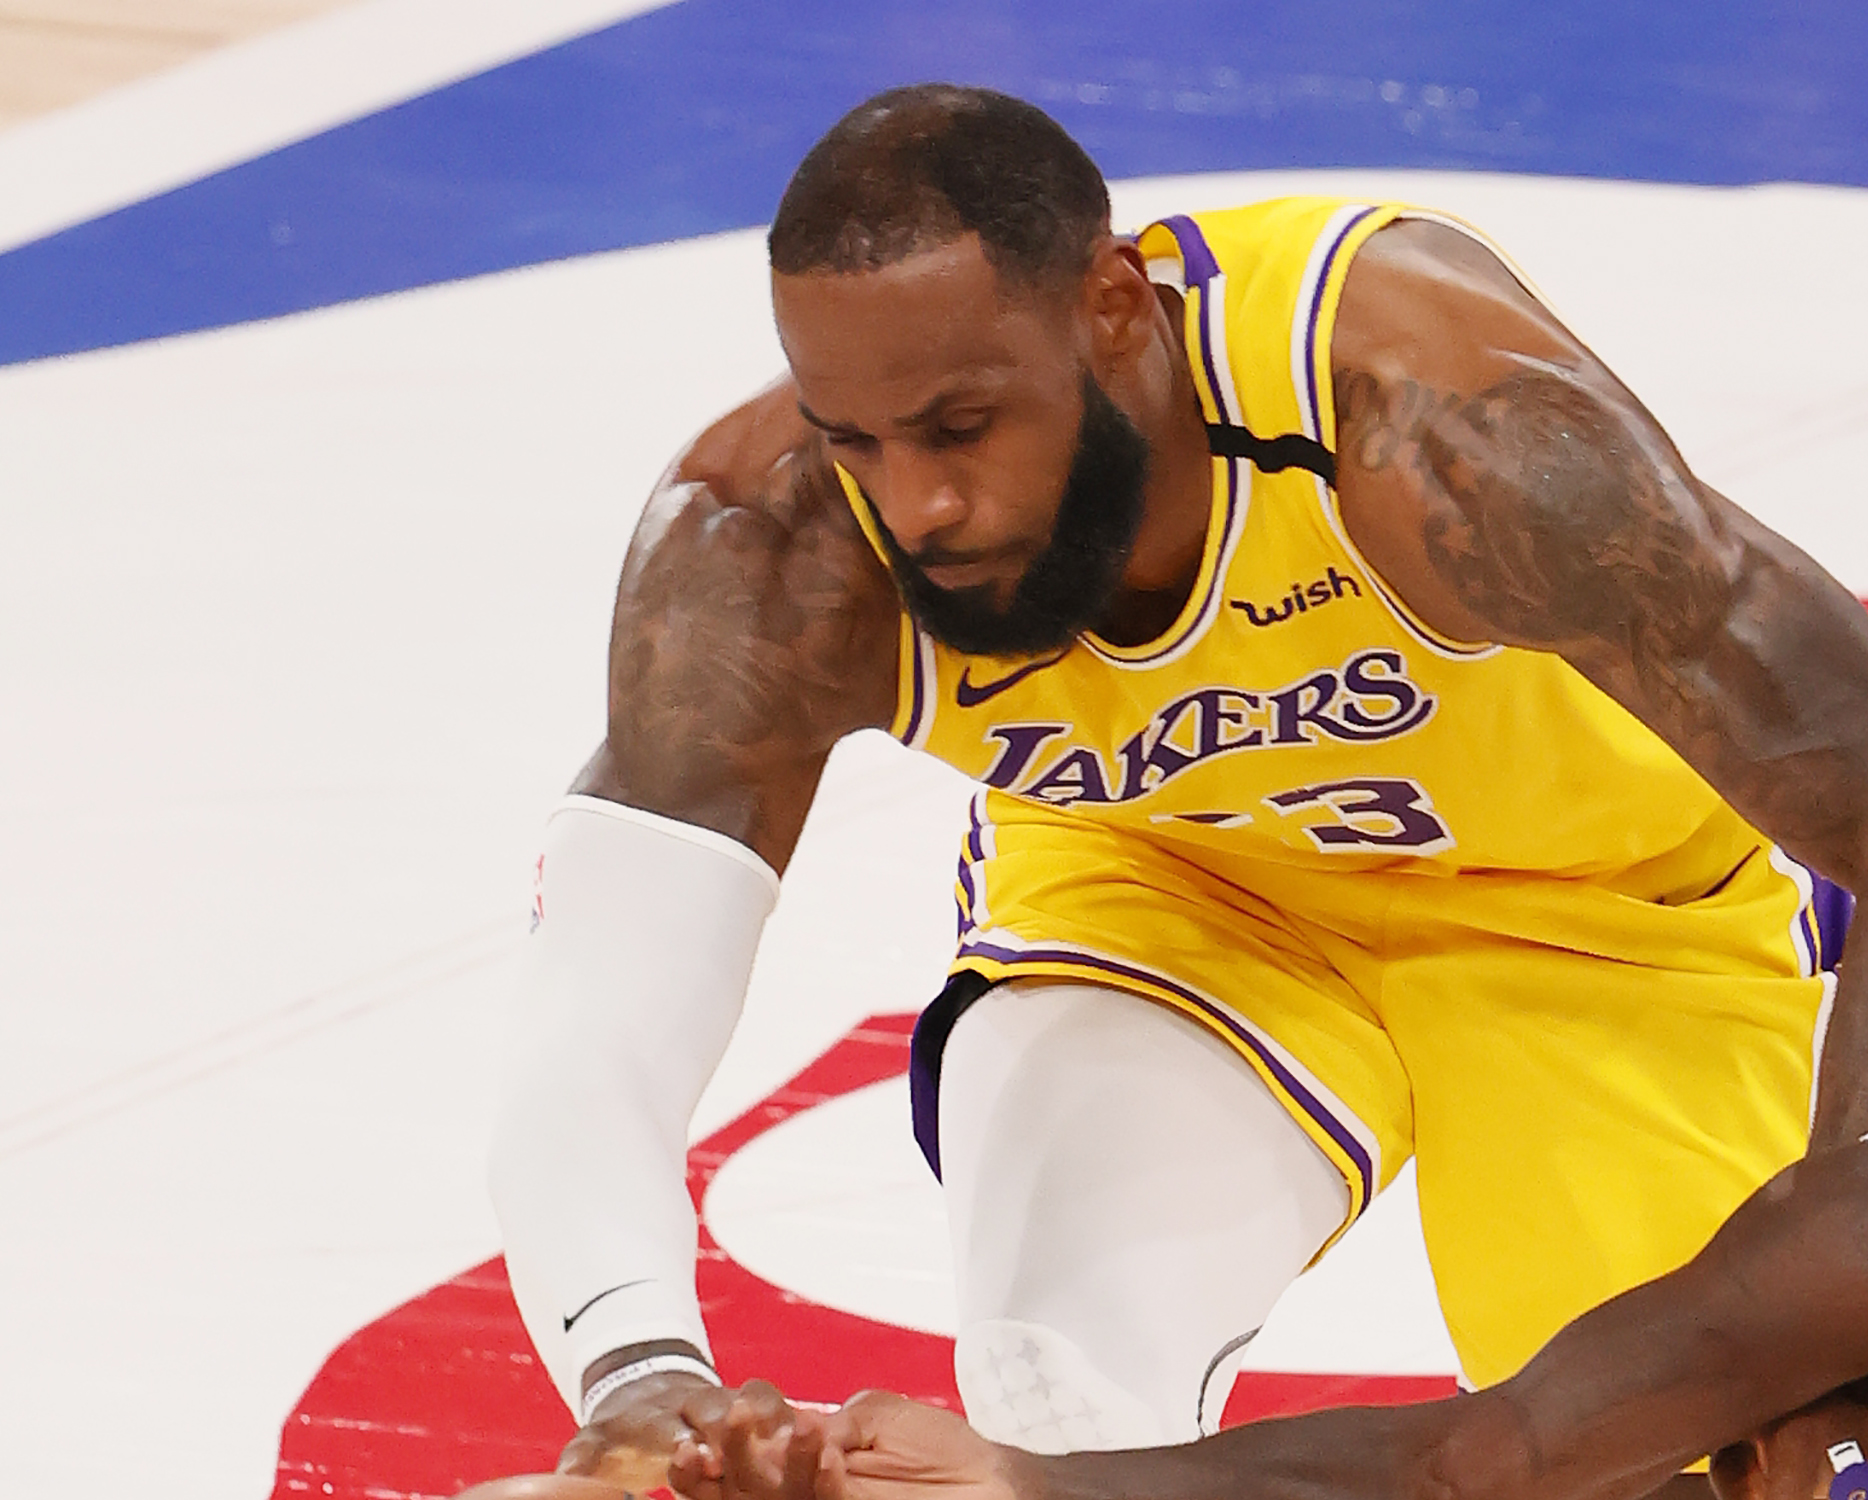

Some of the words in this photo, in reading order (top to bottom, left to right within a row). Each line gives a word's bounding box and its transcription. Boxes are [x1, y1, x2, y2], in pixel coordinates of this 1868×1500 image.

[1230, 566, 1363, 628] wish
[982, 646, 1440, 808] LAKERS
[1150, 776, 1458, 857] 3
